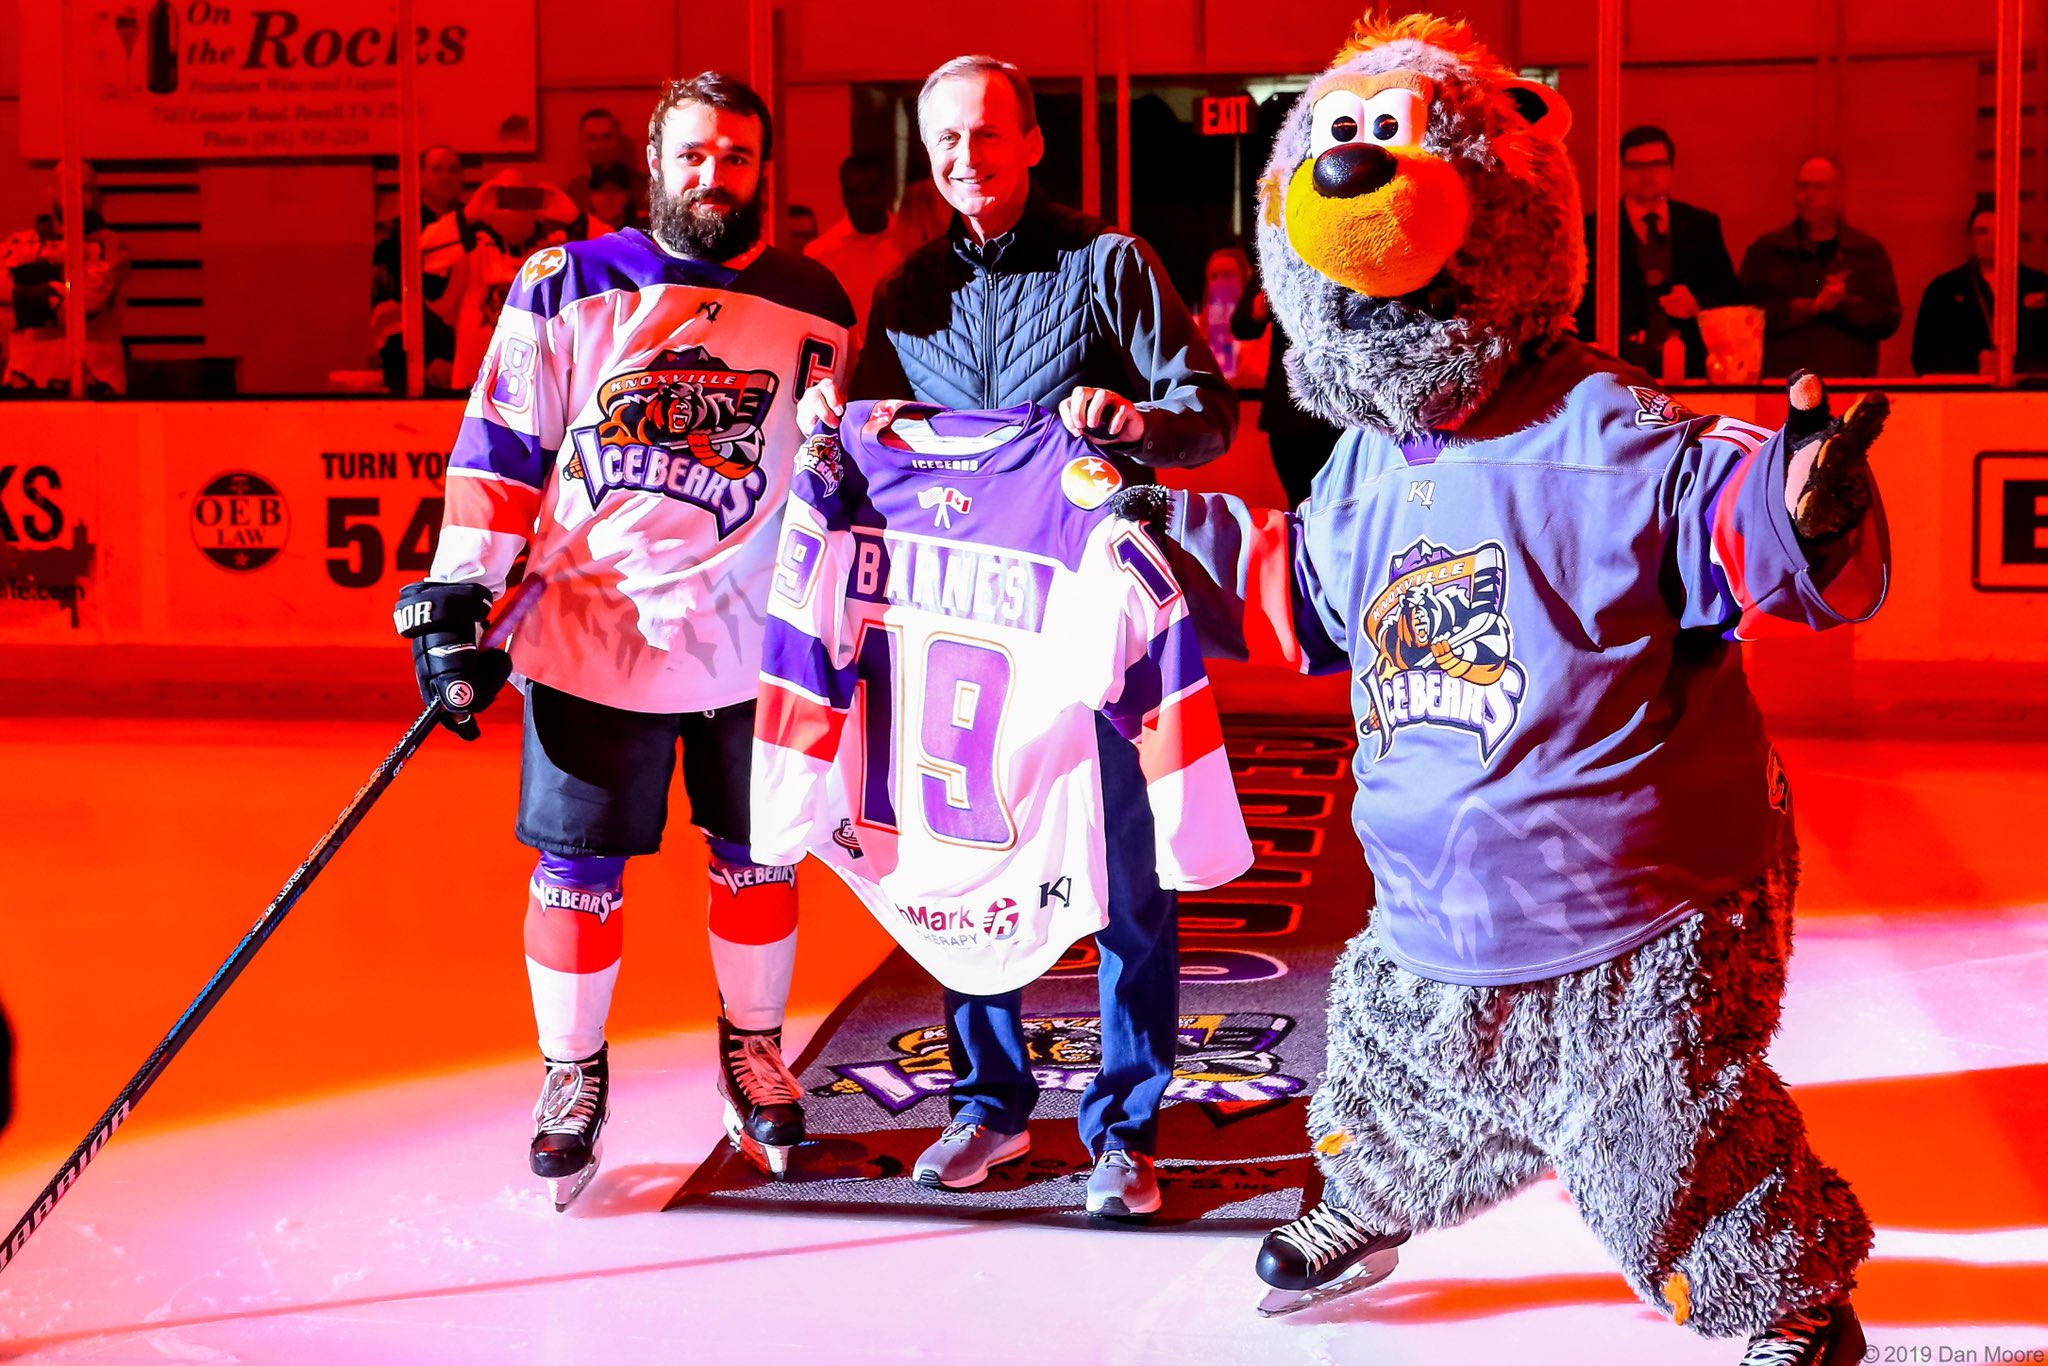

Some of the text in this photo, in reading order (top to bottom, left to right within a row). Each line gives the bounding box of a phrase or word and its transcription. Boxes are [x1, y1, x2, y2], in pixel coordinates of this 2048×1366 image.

[186, 0, 232, 26] On
[186, 40, 236, 66] the
[1203, 96, 1249, 135] EXIT
[609, 373, 737, 394] KNOXVILLE
[321, 452, 450, 480] TURN YO
[196, 498, 282, 527] OEB
[218, 528, 266, 545] LAW
[1110, 521, 1182, 609] 1
[857, 542, 1027, 622] BARNES
[1372, 561, 1466, 622] KNOXVILLE
[855, 617, 1018, 851] 19
